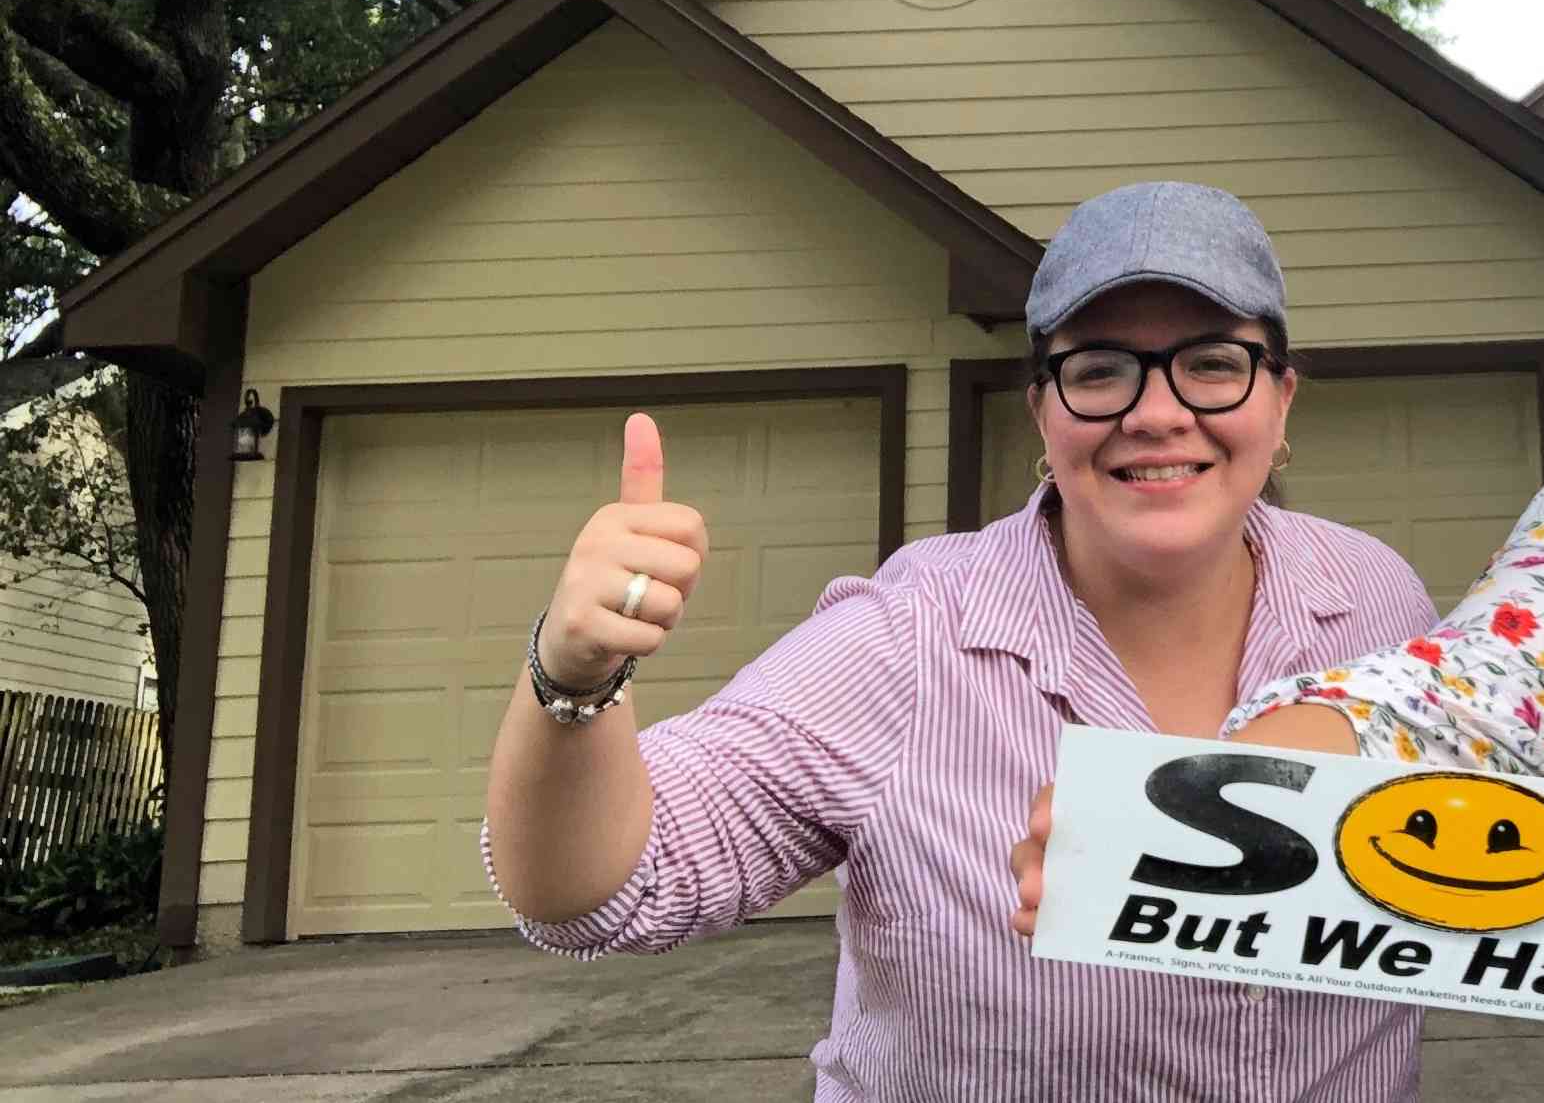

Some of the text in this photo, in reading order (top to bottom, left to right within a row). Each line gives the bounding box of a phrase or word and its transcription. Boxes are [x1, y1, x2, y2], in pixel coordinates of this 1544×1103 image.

[1108, 894, 1271, 958] But
[1300, 916, 1432, 977] We
[1208, 963, 1230, 973] PVC
[1233, 965, 1258, 977] Yard
[1261, 968, 1292, 980] Posts
[1295, 973, 1304, 982] &
[1307, 975, 1323, 984] All
[1326, 977, 1351, 988] Your
[1355, 980, 1403, 994] Outdoor
[1406, 986, 1467, 1003] Marketing
[1470, 994, 1507, 1007] Needs
[1510, 999, 1531, 1010] Call
